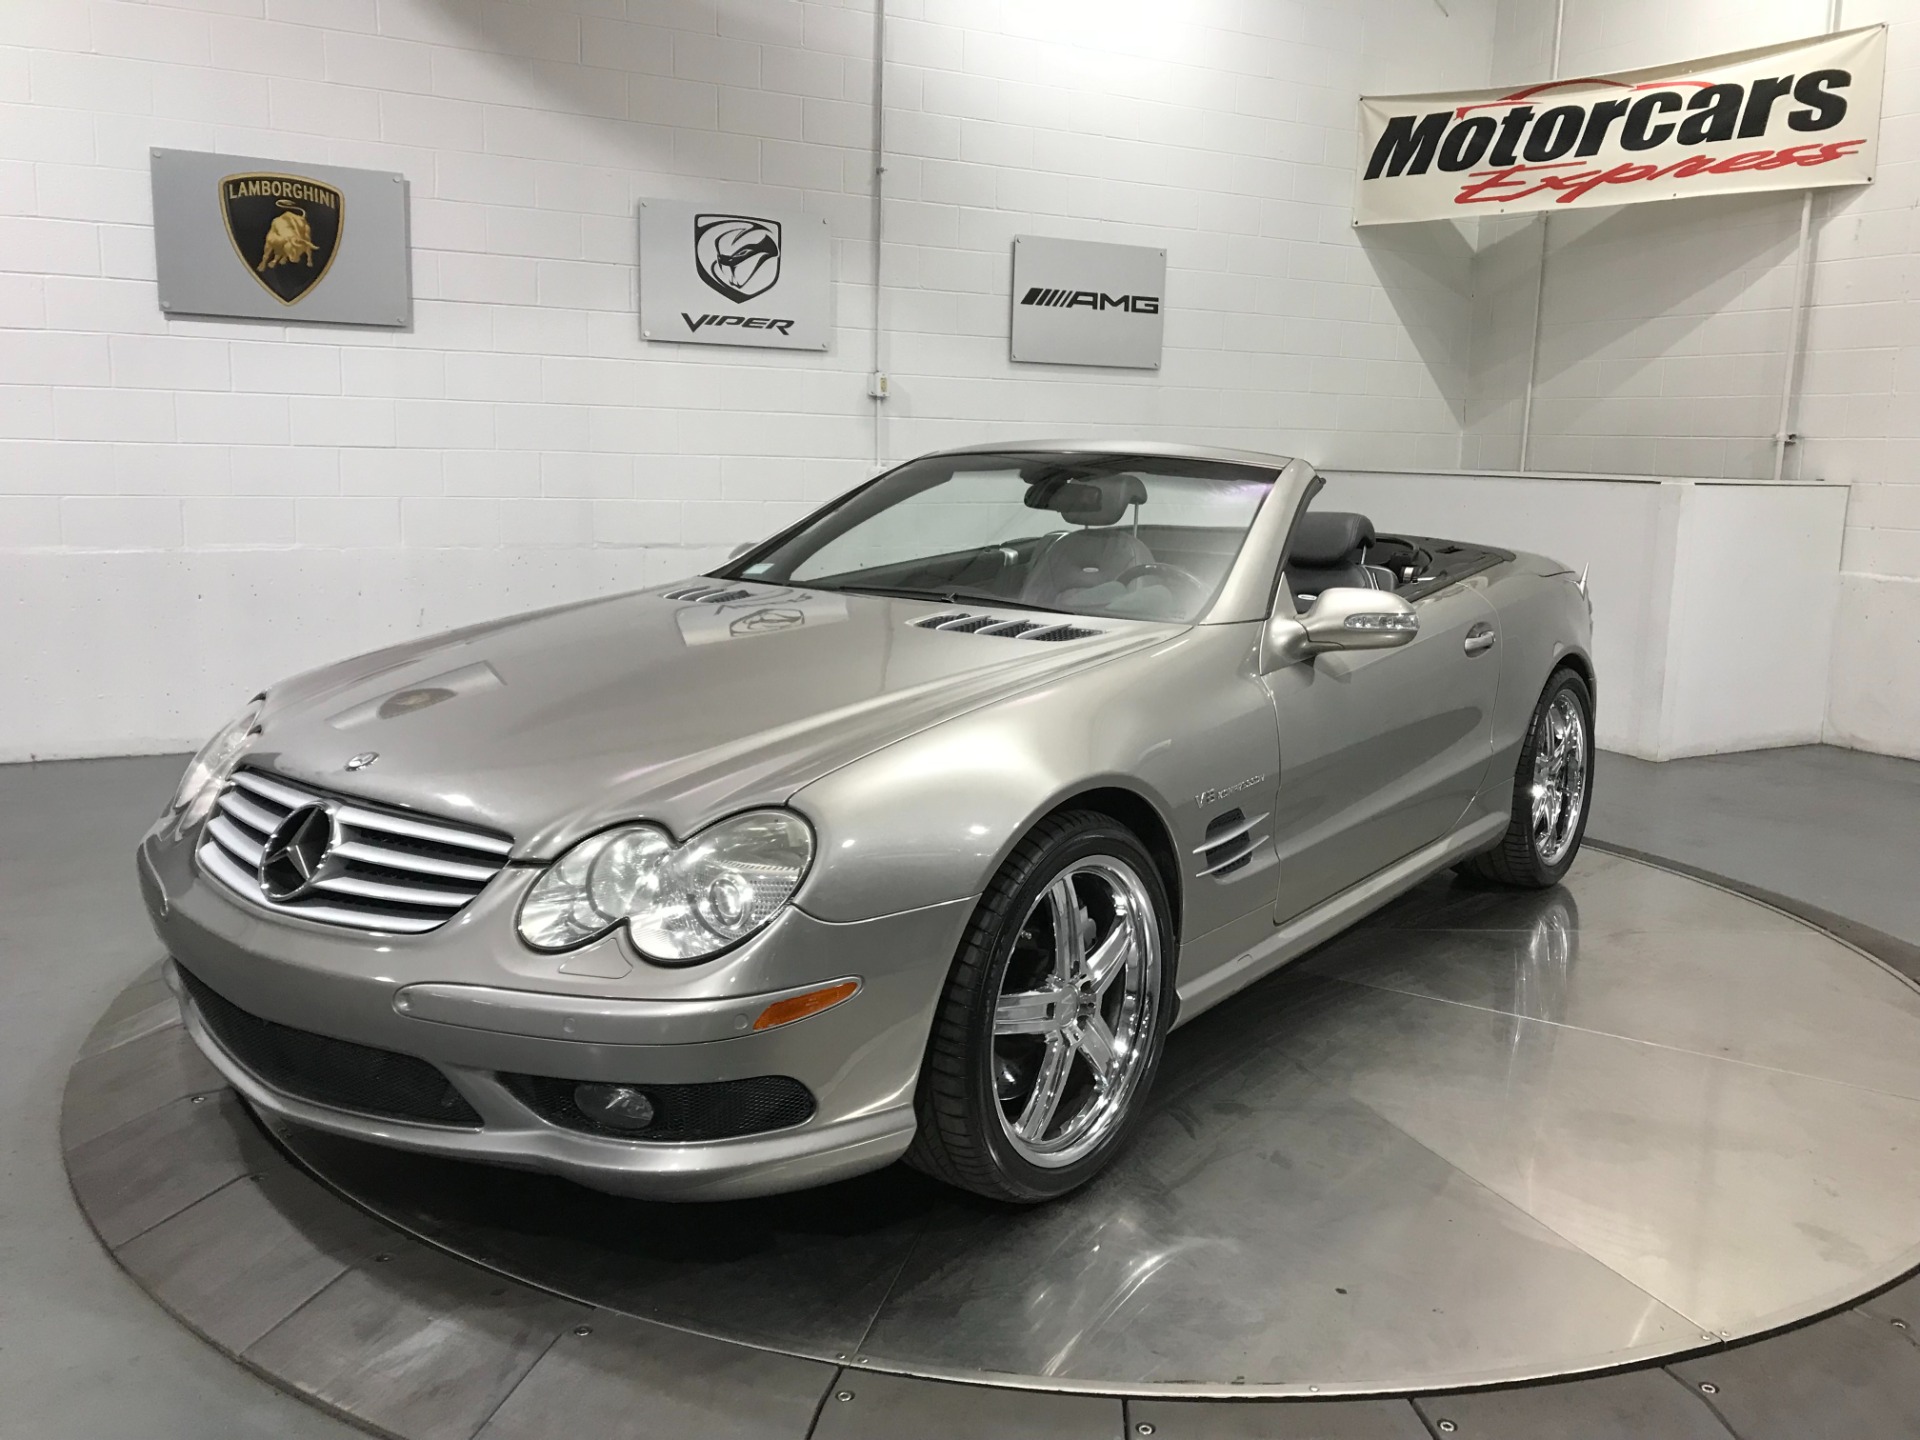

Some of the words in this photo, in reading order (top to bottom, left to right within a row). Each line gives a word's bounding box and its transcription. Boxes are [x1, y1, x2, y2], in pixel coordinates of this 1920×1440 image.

[1363, 69, 1852, 181] Motorcars
[229, 180, 336, 209] LAMBORGHINI
[1454, 139, 1868, 204] Express
[681, 312, 795, 336] VIPER
